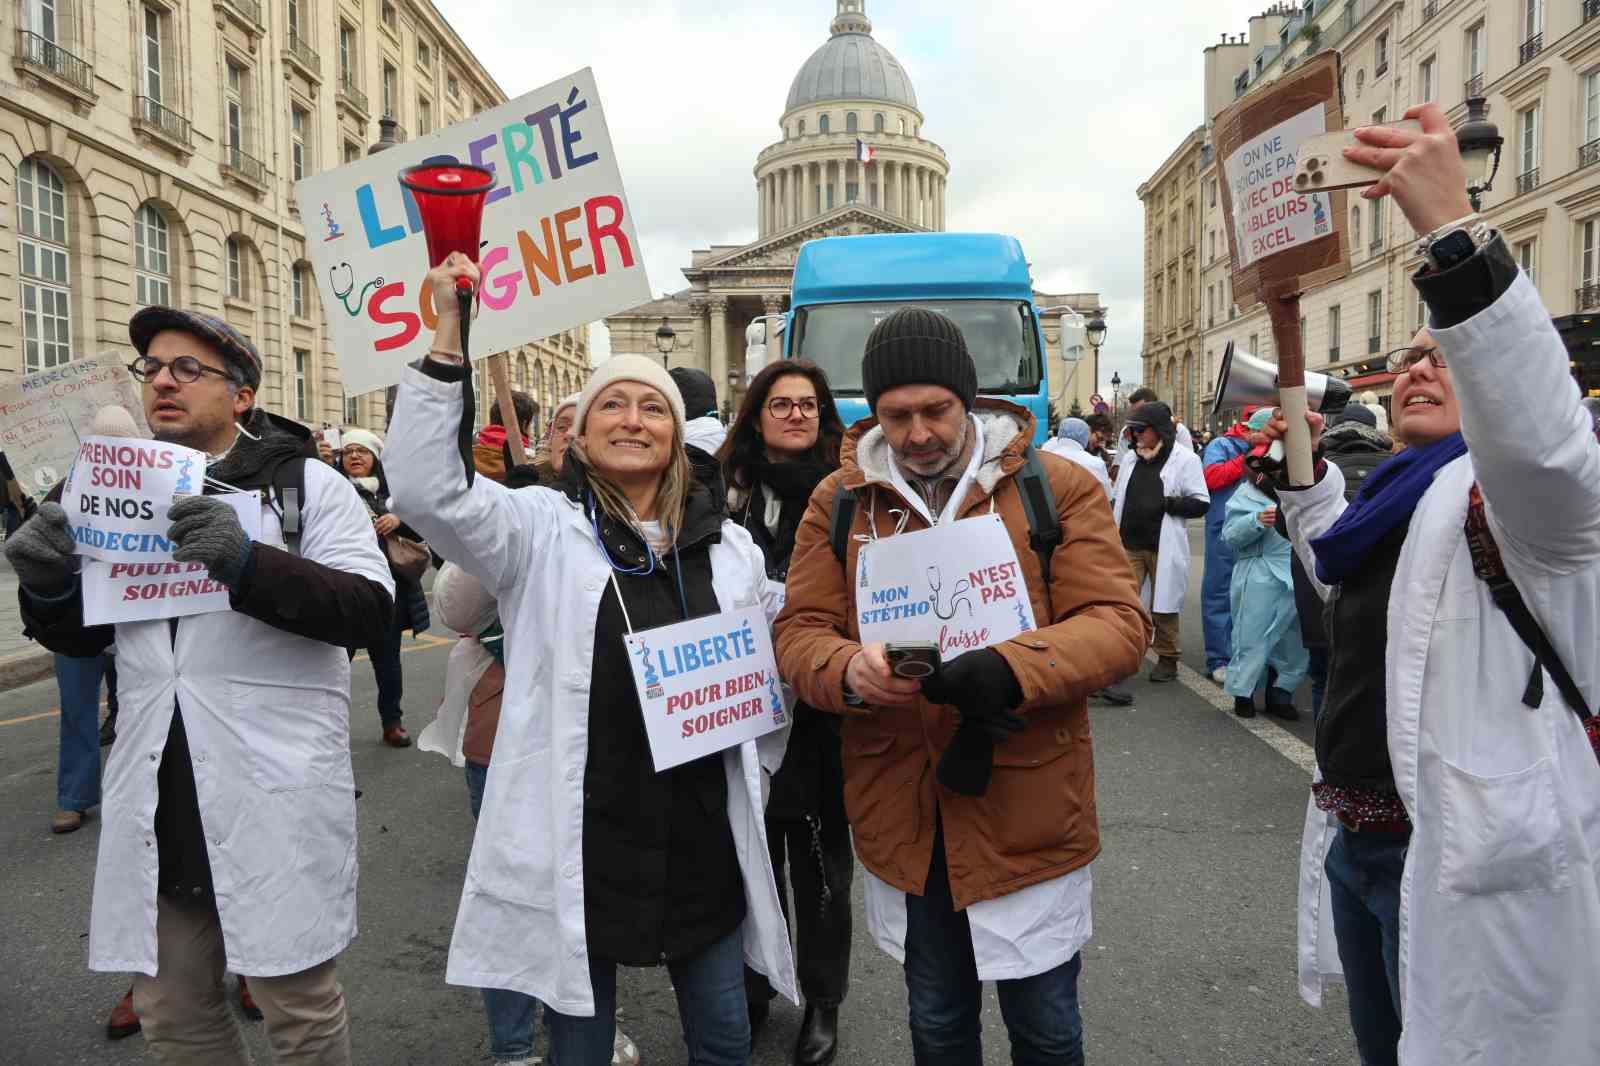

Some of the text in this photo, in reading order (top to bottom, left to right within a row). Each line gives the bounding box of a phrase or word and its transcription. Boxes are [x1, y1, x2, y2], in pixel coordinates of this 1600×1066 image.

[1243, 136, 1282, 167] ON NE
[1277, 149, 1299, 173] PA
[356, 86, 599, 249] LIERTÉ
[1272, 176, 1295, 198] DE
[1252, 226, 1296, 256] EXCEL
[367, 194, 635, 351] SGNER
[80, 442, 174, 470] PRENONS
[91, 467, 142, 490] SOIN
[80, 494, 100, 515] DE
[105, 497, 154, 520] NOS
[67, 522, 176, 553] MÉDECIN
[969, 562, 1018, 588] N'EST
[871, 586, 909, 605] MON
[981, 581, 1017, 604] PAS
[861, 601, 930, 625] STÉTHO
[658, 619, 756, 678] LIBERTÉ
[939, 625, 991, 654] laisse
[666, 683, 722, 715] POUR
[725, 670, 765, 698] BIEN
[682, 697, 764, 738] SOIGNER
